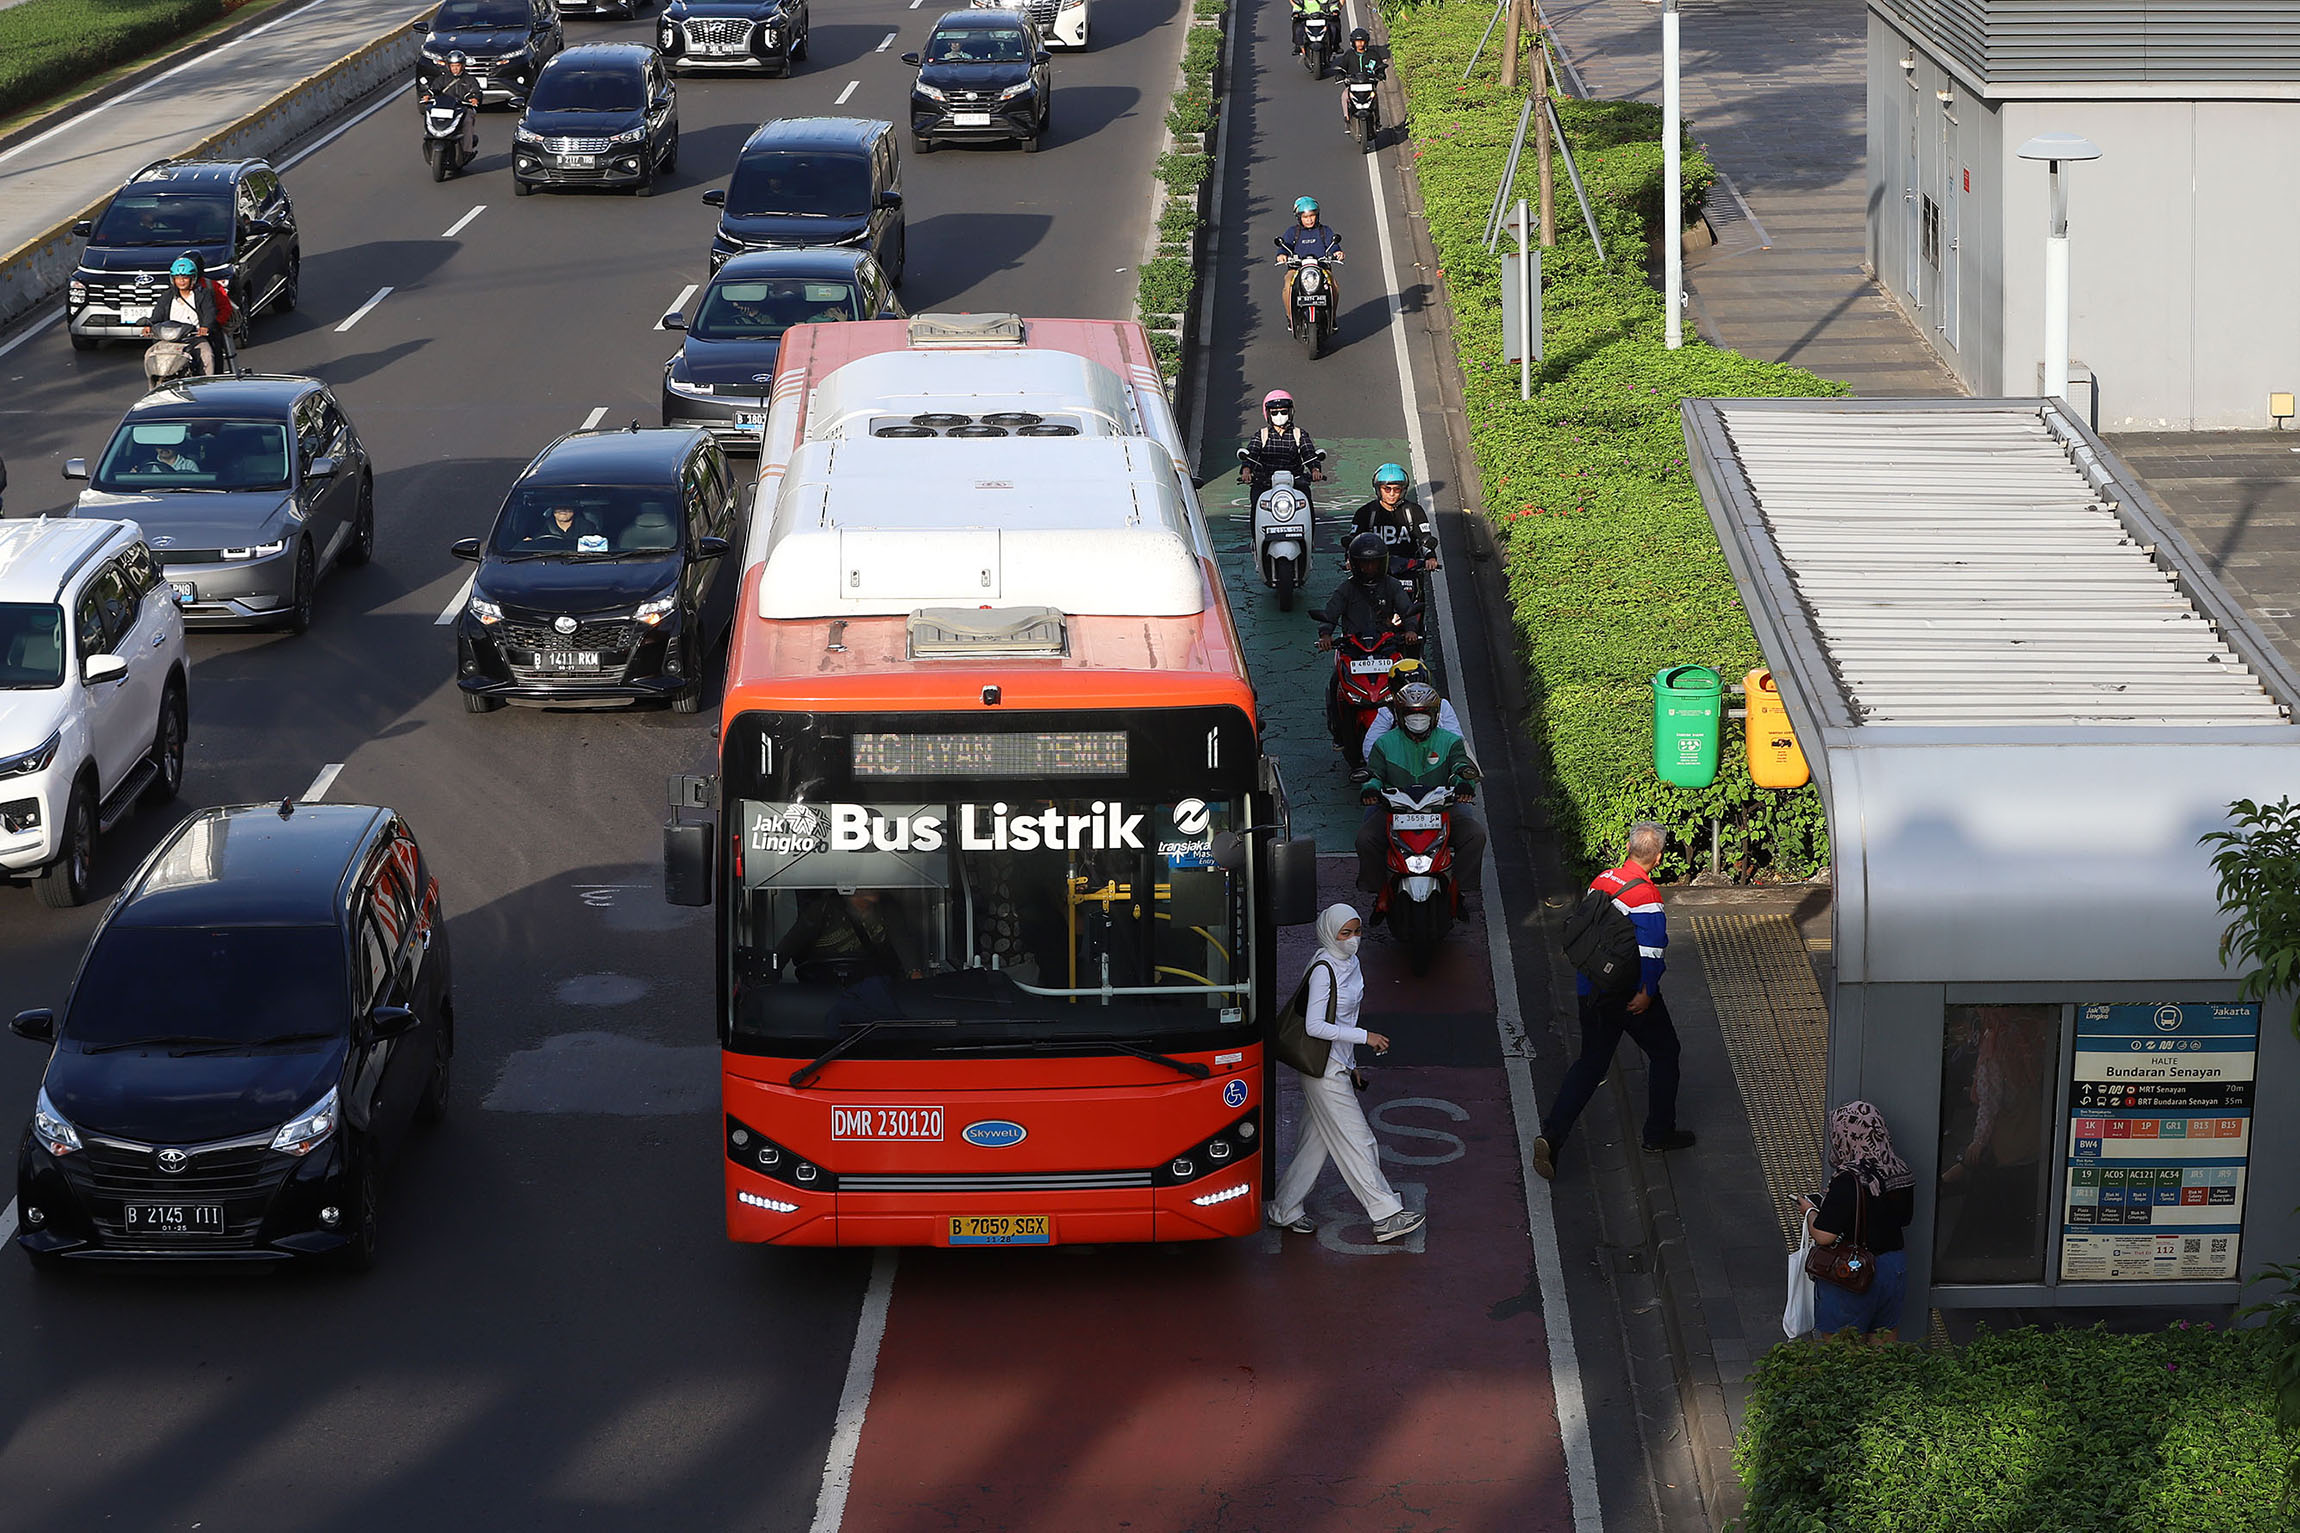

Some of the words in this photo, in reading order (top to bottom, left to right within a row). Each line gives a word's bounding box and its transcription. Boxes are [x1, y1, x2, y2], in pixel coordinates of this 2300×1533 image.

[737, 413, 743, 424] B
[534, 653, 541, 665] B
[550, 652, 573, 665] 1411
[578, 652, 598, 665] RKM
[752, 814, 784, 833] Jak
[831, 804, 943, 851] Bus
[962, 801, 1144, 850] Listrik
[752, 832, 813, 854] Lingko
[2213, 1006, 2250, 1016] Jakarta
[2106, 1067, 2166, 1077] Bundaran
[2169, 1067, 2221, 1079] Senayan
[2157, 1086, 2186, 1094] Senayan
[2188, 1098, 2218, 1107] Senayan
[834, 1110, 872, 1136] DMR
[877, 1111, 940, 1137] 230120
[2113, 1122, 2124, 1130] 1N
[970, 1128, 1019, 1139] Skywell
[2080, 1140, 2098, 1148] BW4
[128, 1208, 137, 1223] B
[147, 1208, 183, 1224] 2145
[952, 1220, 962, 1234] B
[970, 1219, 1008, 1234] 7059
[1015, 1218, 1045, 1234] SGX
